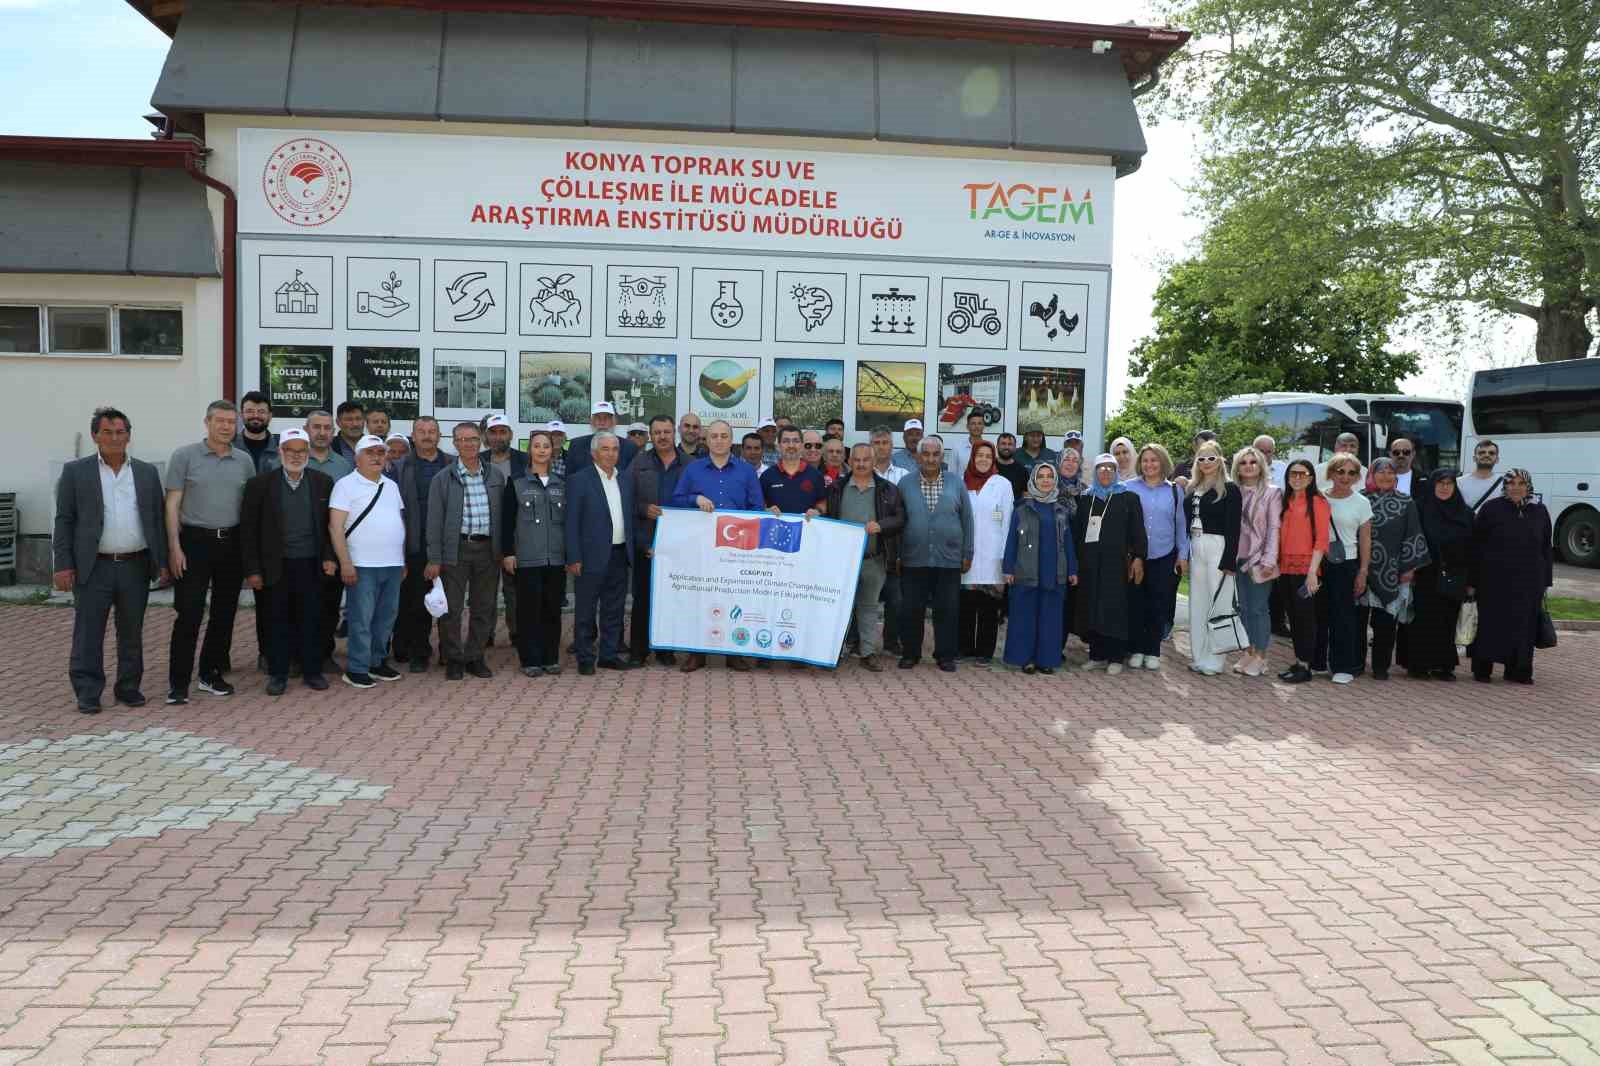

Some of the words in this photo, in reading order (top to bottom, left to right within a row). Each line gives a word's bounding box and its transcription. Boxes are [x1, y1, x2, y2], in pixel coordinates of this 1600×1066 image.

[566, 151, 646, 173] KONYA
[651, 154, 745, 177] TOPRAK
[751, 159, 782, 179] SU
[786, 160, 816, 180] VE
[540, 175, 664, 205] ÇÖLLEŞME
[670, 180, 704, 203] İLE
[710, 182, 838, 209] MÜCADELE
[963, 181, 1095, 225] TAGEM
[471, 204, 611, 229] ARAŞTIRMA
[617, 208, 746, 233] ENSTİTÜSÜ
[752, 212, 903, 240] MÜDÜRLÜĞÜ
[1014, 230, 1020, 240] &
[1022, 229, 1076, 242] İNOVASYON
[373, 367, 419, 379] YEŞEREN
[287, 383, 304, 391] TEK
[352, 389, 419, 400] KARAPINAR
[705, 575, 719, 583] and
[720, 576, 755, 586] Expansion
[756, 578, 763, 586] of
[715, 585, 751, 595] Production
